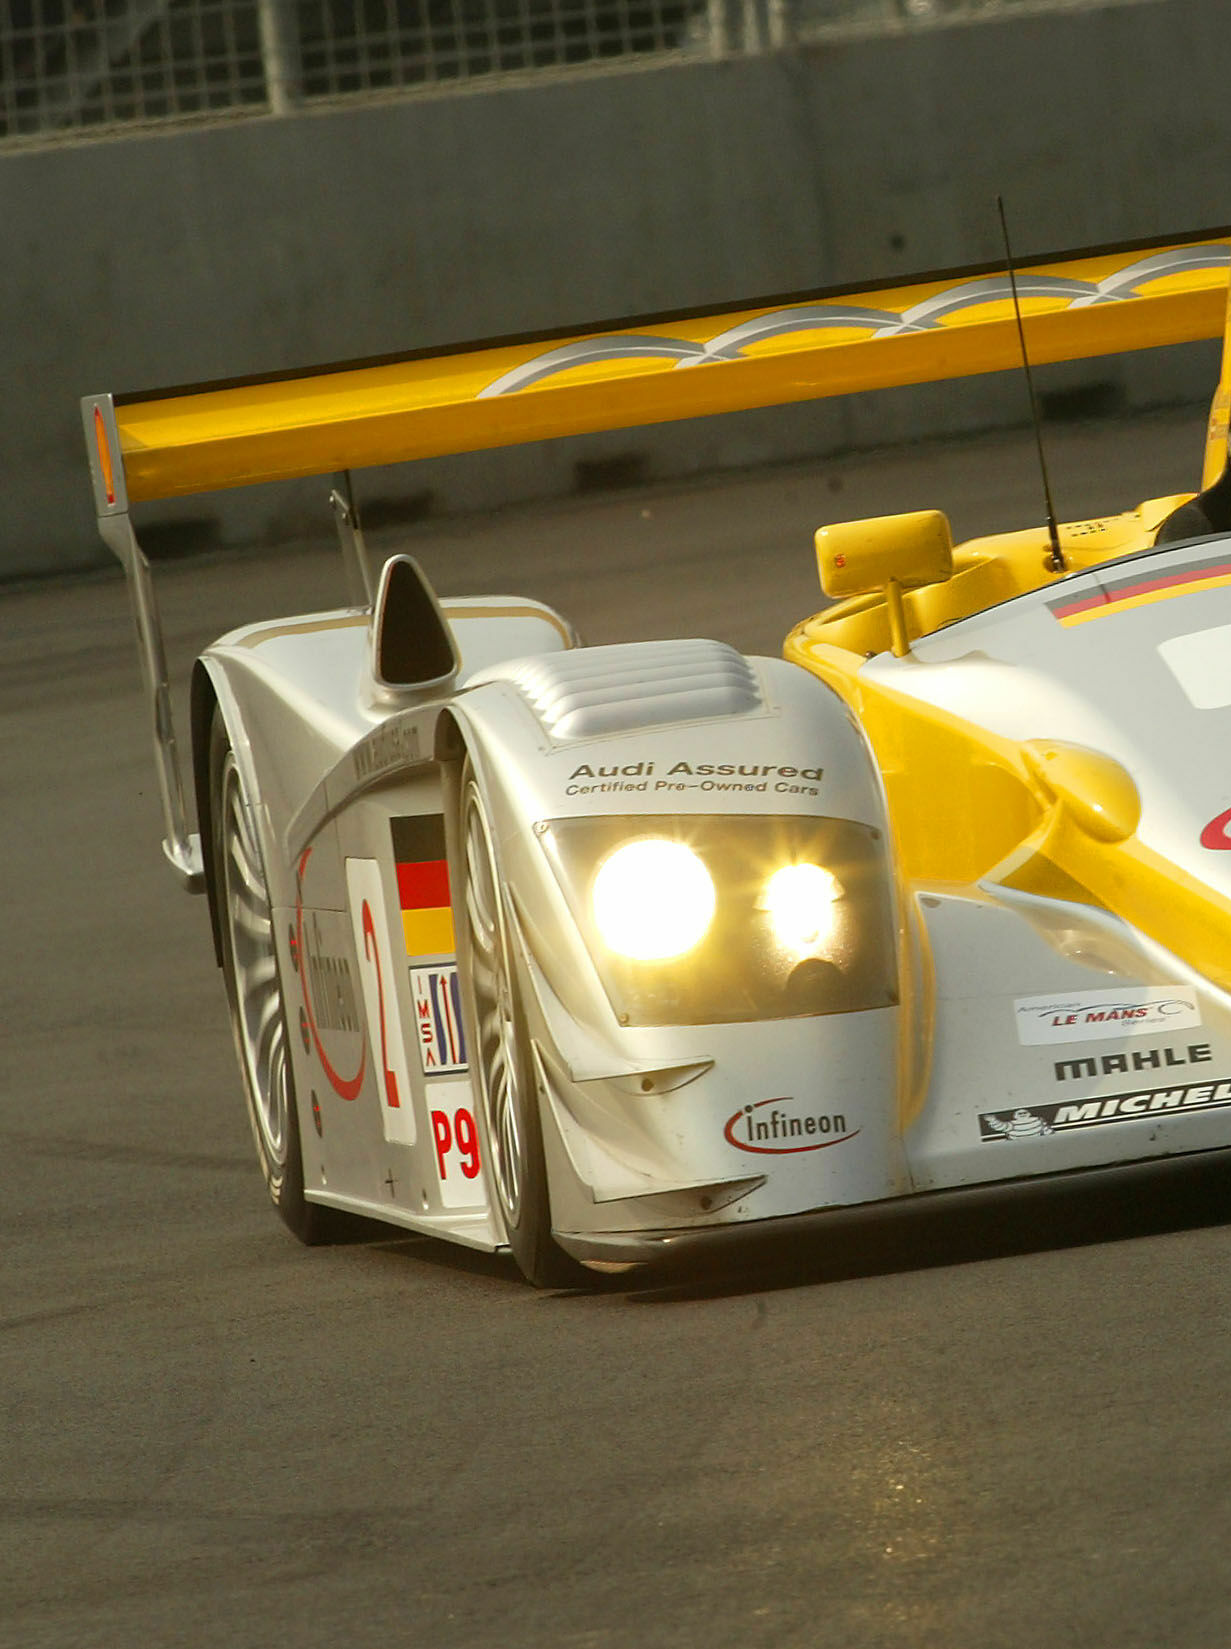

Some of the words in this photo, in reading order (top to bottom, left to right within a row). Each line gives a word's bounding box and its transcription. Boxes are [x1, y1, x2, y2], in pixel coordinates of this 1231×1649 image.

[565, 780, 648, 796] Certified
[654, 779, 768, 793] Pre-Owned
[774, 781, 820, 796] Cars
[567, 761, 655, 780] Audi
[666, 761, 824, 781] Assured
[361, 897, 401, 1109] 2
[416, 974, 437, 1067] IMSA
[1051, 1013, 1078, 1027] LE
[1084, 1006, 1150, 1024] MANS
[1053, 1043, 1214, 1081] MAHLE
[430, 1107, 482, 1181] P9
